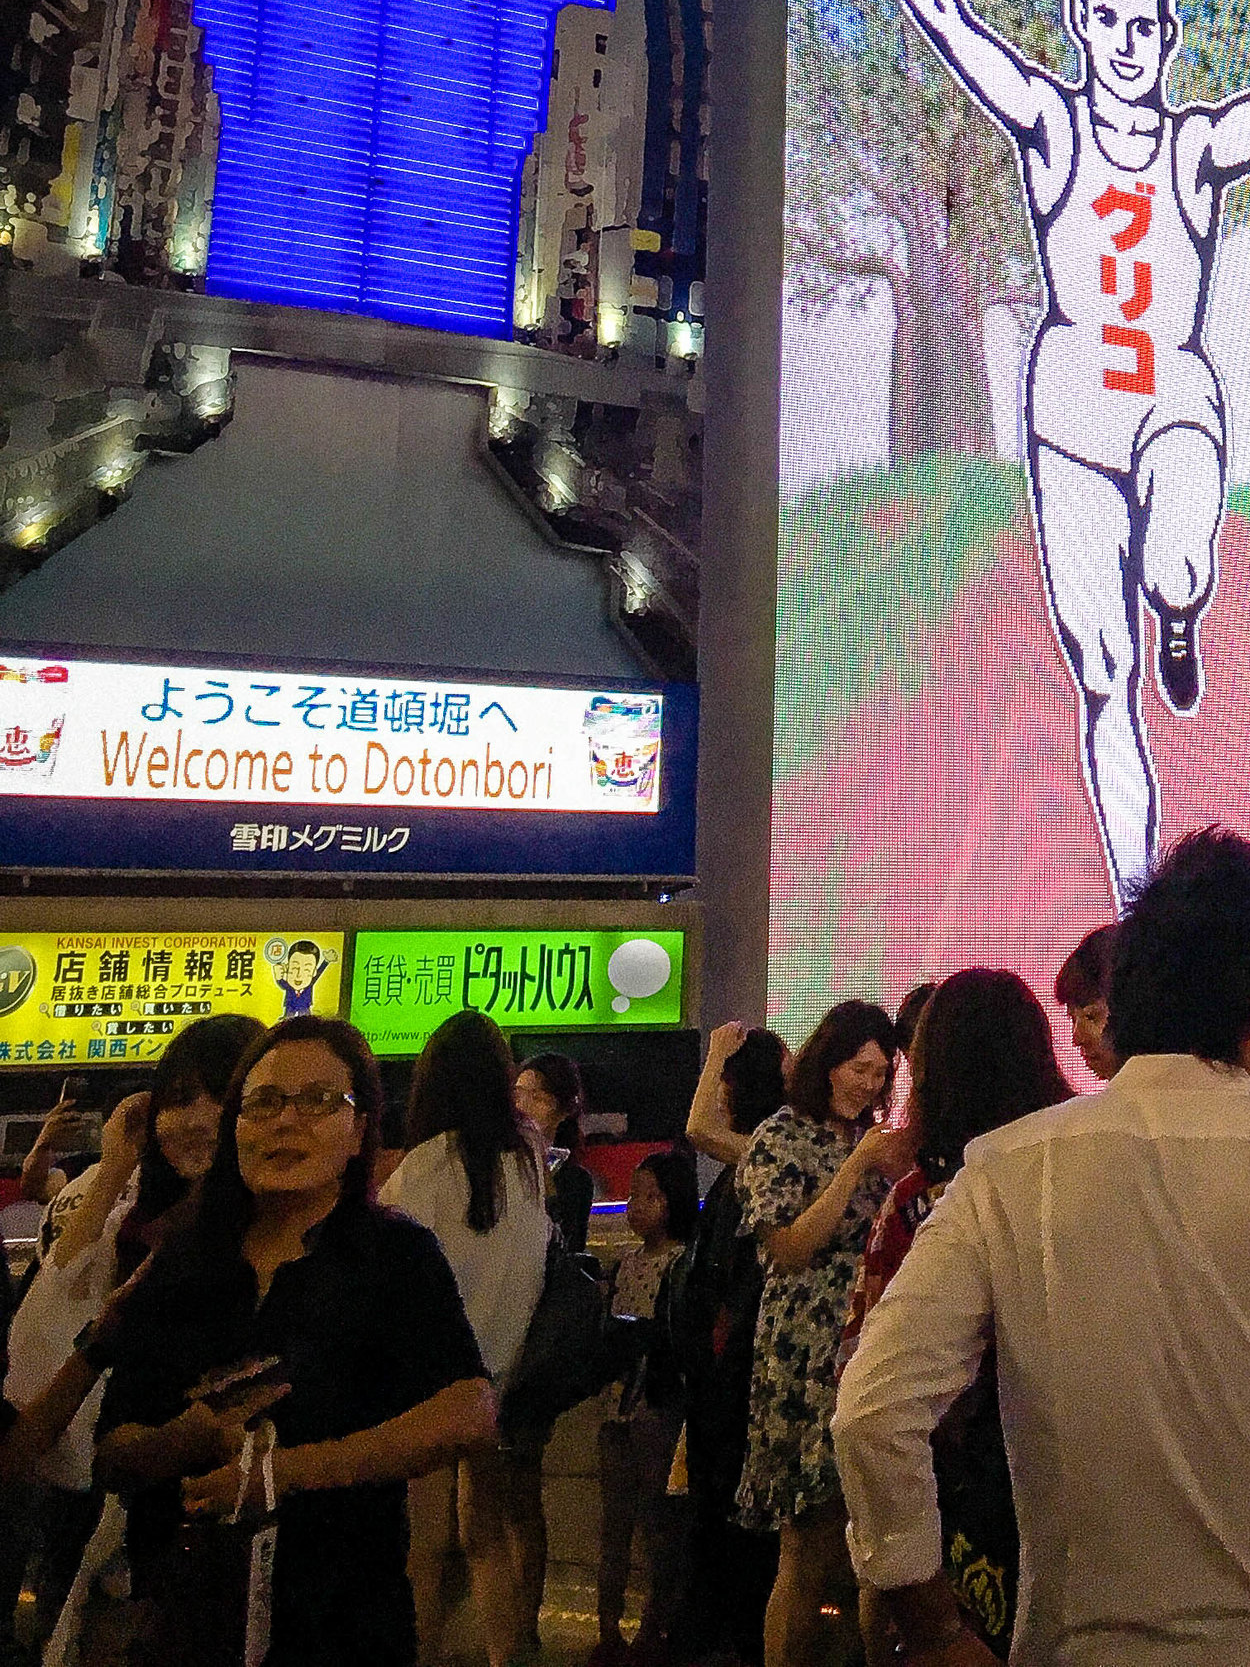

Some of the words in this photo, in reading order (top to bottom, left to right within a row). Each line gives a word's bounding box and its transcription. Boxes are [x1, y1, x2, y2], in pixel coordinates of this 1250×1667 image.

[1091, 181, 1156, 396] グリコ
[141, 677, 519, 736] ようこそ道頓堀へ
[100, 728, 294, 793] Welcome
[308, 744, 348, 795] to
[363, 740, 554, 800] Dotonbori
[611, 750, 635, 779] 恵
[229, 822, 412, 854] 雪印メグミルク
[56, 936, 108, 950] KANSAI
[111, 936, 159, 949] INVEST
[163, 936, 257, 949] CORPORATION
[53, 948, 256, 984] 店舗情報館
[362, 953, 456, 1007] 賃貸・売買
[461, 942, 595, 1013] ピタットハウス
[51, 983, 254, 1002] 居抜き店舗総合プロデュース
[143, 1001, 211, 1016] 買いたい
[54, 1002, 123, 1018] 借りたい
